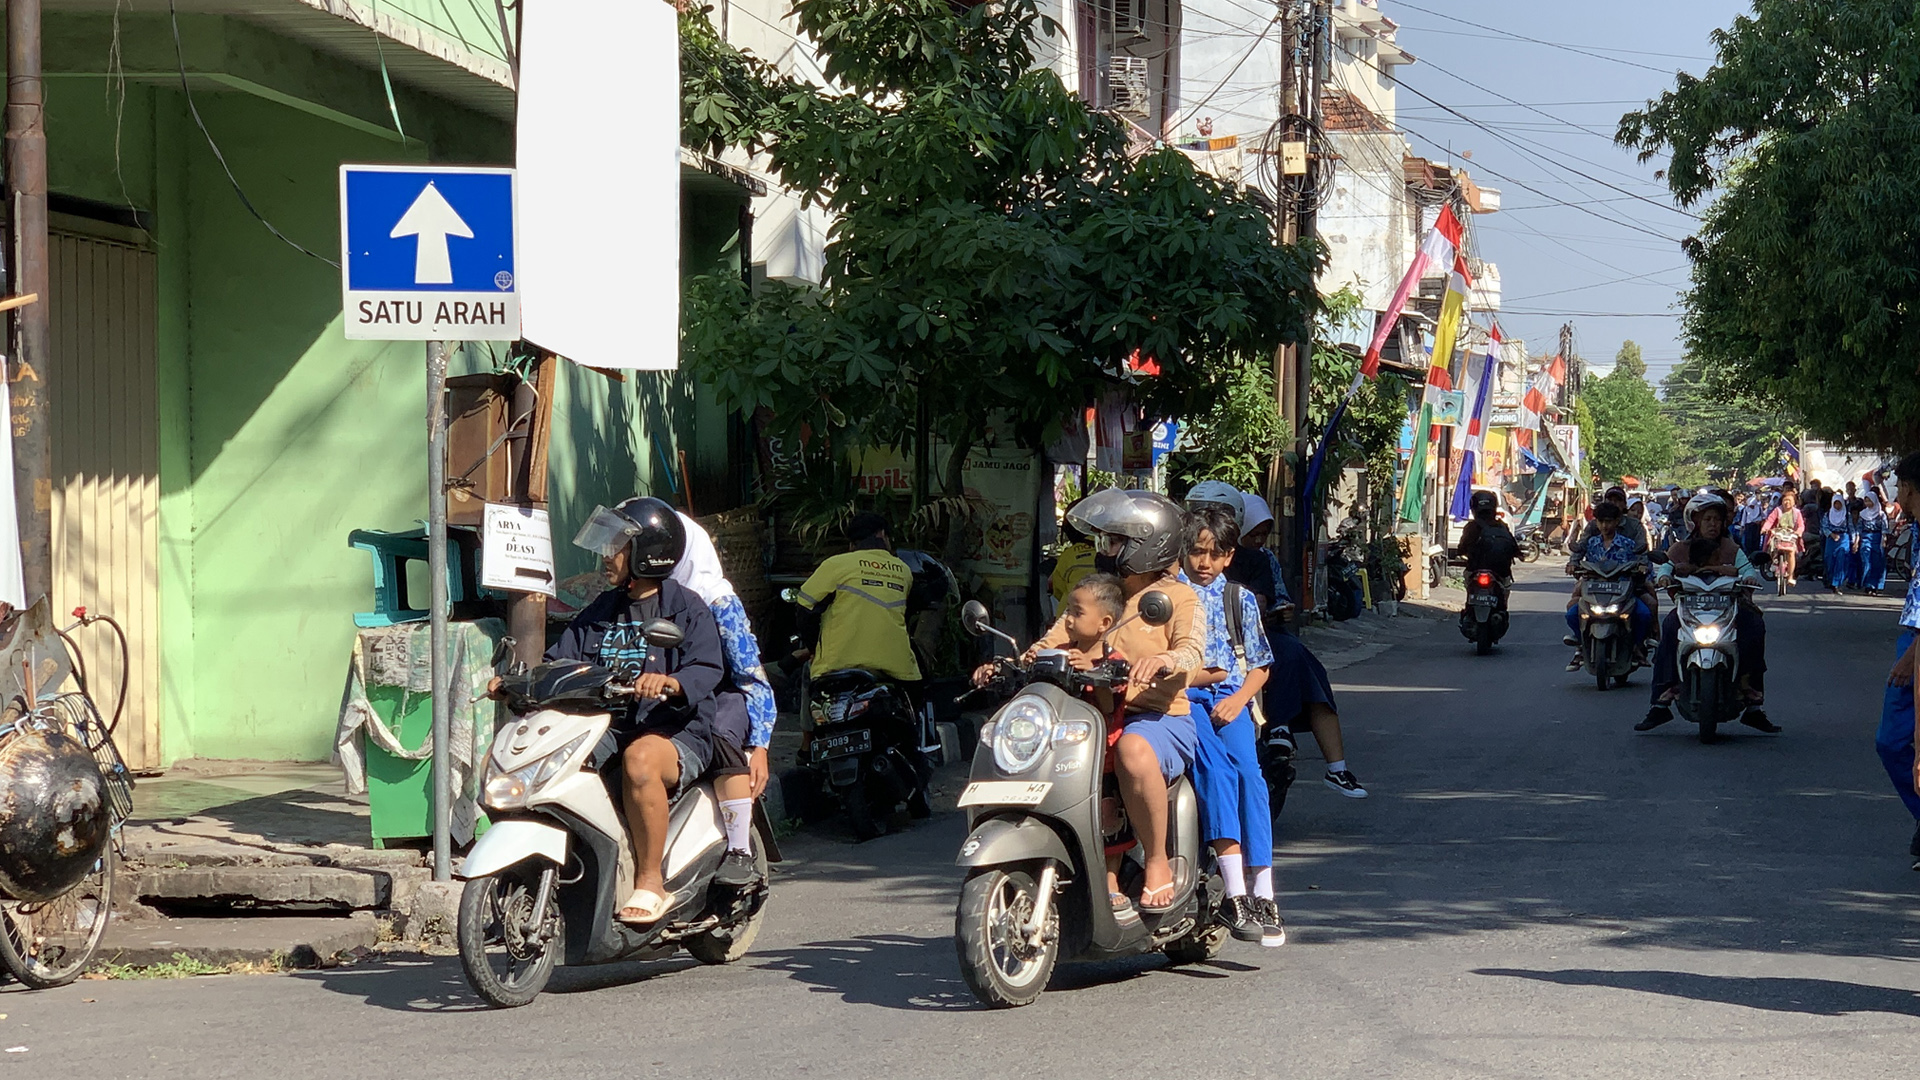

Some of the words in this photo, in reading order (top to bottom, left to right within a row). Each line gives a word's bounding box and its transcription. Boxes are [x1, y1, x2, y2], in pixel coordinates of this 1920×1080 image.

[358, 300, 422, 325] SATU
[434, 301, 506, 325] ARAH
[972, 461, 1000, 470] JAMU
[1003, 462, 1031, 471] JAGO
[497, 520, 522, 531] ARYA
[506, 543, 536, 554] DEASY
[858, 559, 904, 573] maxim
[812, 743, 819, 751] H
[827, 735, 849, 748] 3089
[967, 784, 979, 794] H
[1026, 783, 1046, 794] WA
